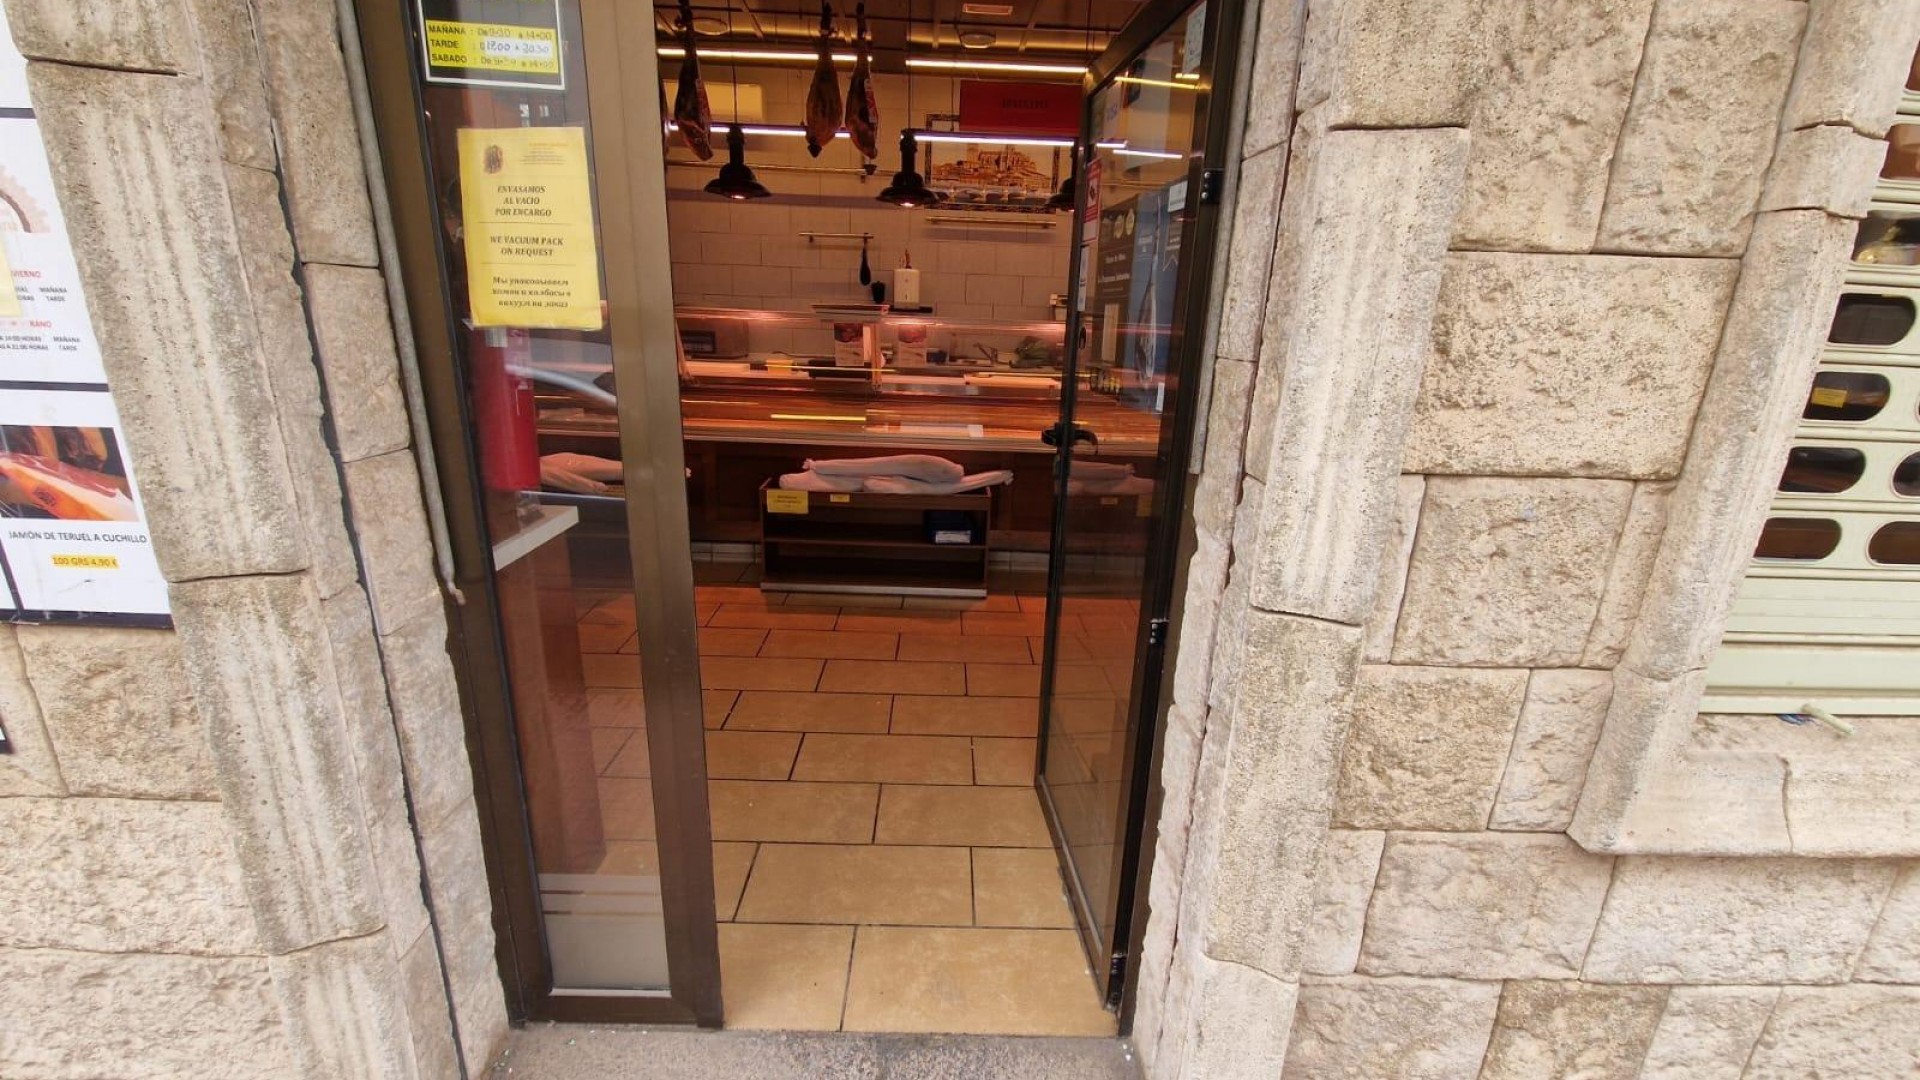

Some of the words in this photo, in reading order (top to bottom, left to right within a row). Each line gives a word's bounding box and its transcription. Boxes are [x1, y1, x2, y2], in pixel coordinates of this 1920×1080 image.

[428, 23, 466, 35] MAÑANA
[430, 39, 459, 49] TARDE
[431, 53, 467, 63] SABADO
[497, 185, 546, 194] ENVASAMOS
[503, 197, 513, 205] AL
[495, 208, 511, 216] POR
[512, 208, 552, 217] ENCARGO
[490, 235, 502, 243] WE
[504, 235, 540, 245] VACUUM
[541, 237, 564, 246] PACK
[501, 247, 513, 256] ON
[515, 247, 553, 257] REQUEST
[44, 532, 56, 540] DE
[57, 532, 91, 541] TERUEL
[94, 533, 101, 541] A
[102, 533, 147, 543] CUCHILLO
[53, 557, 69, 565] 100
